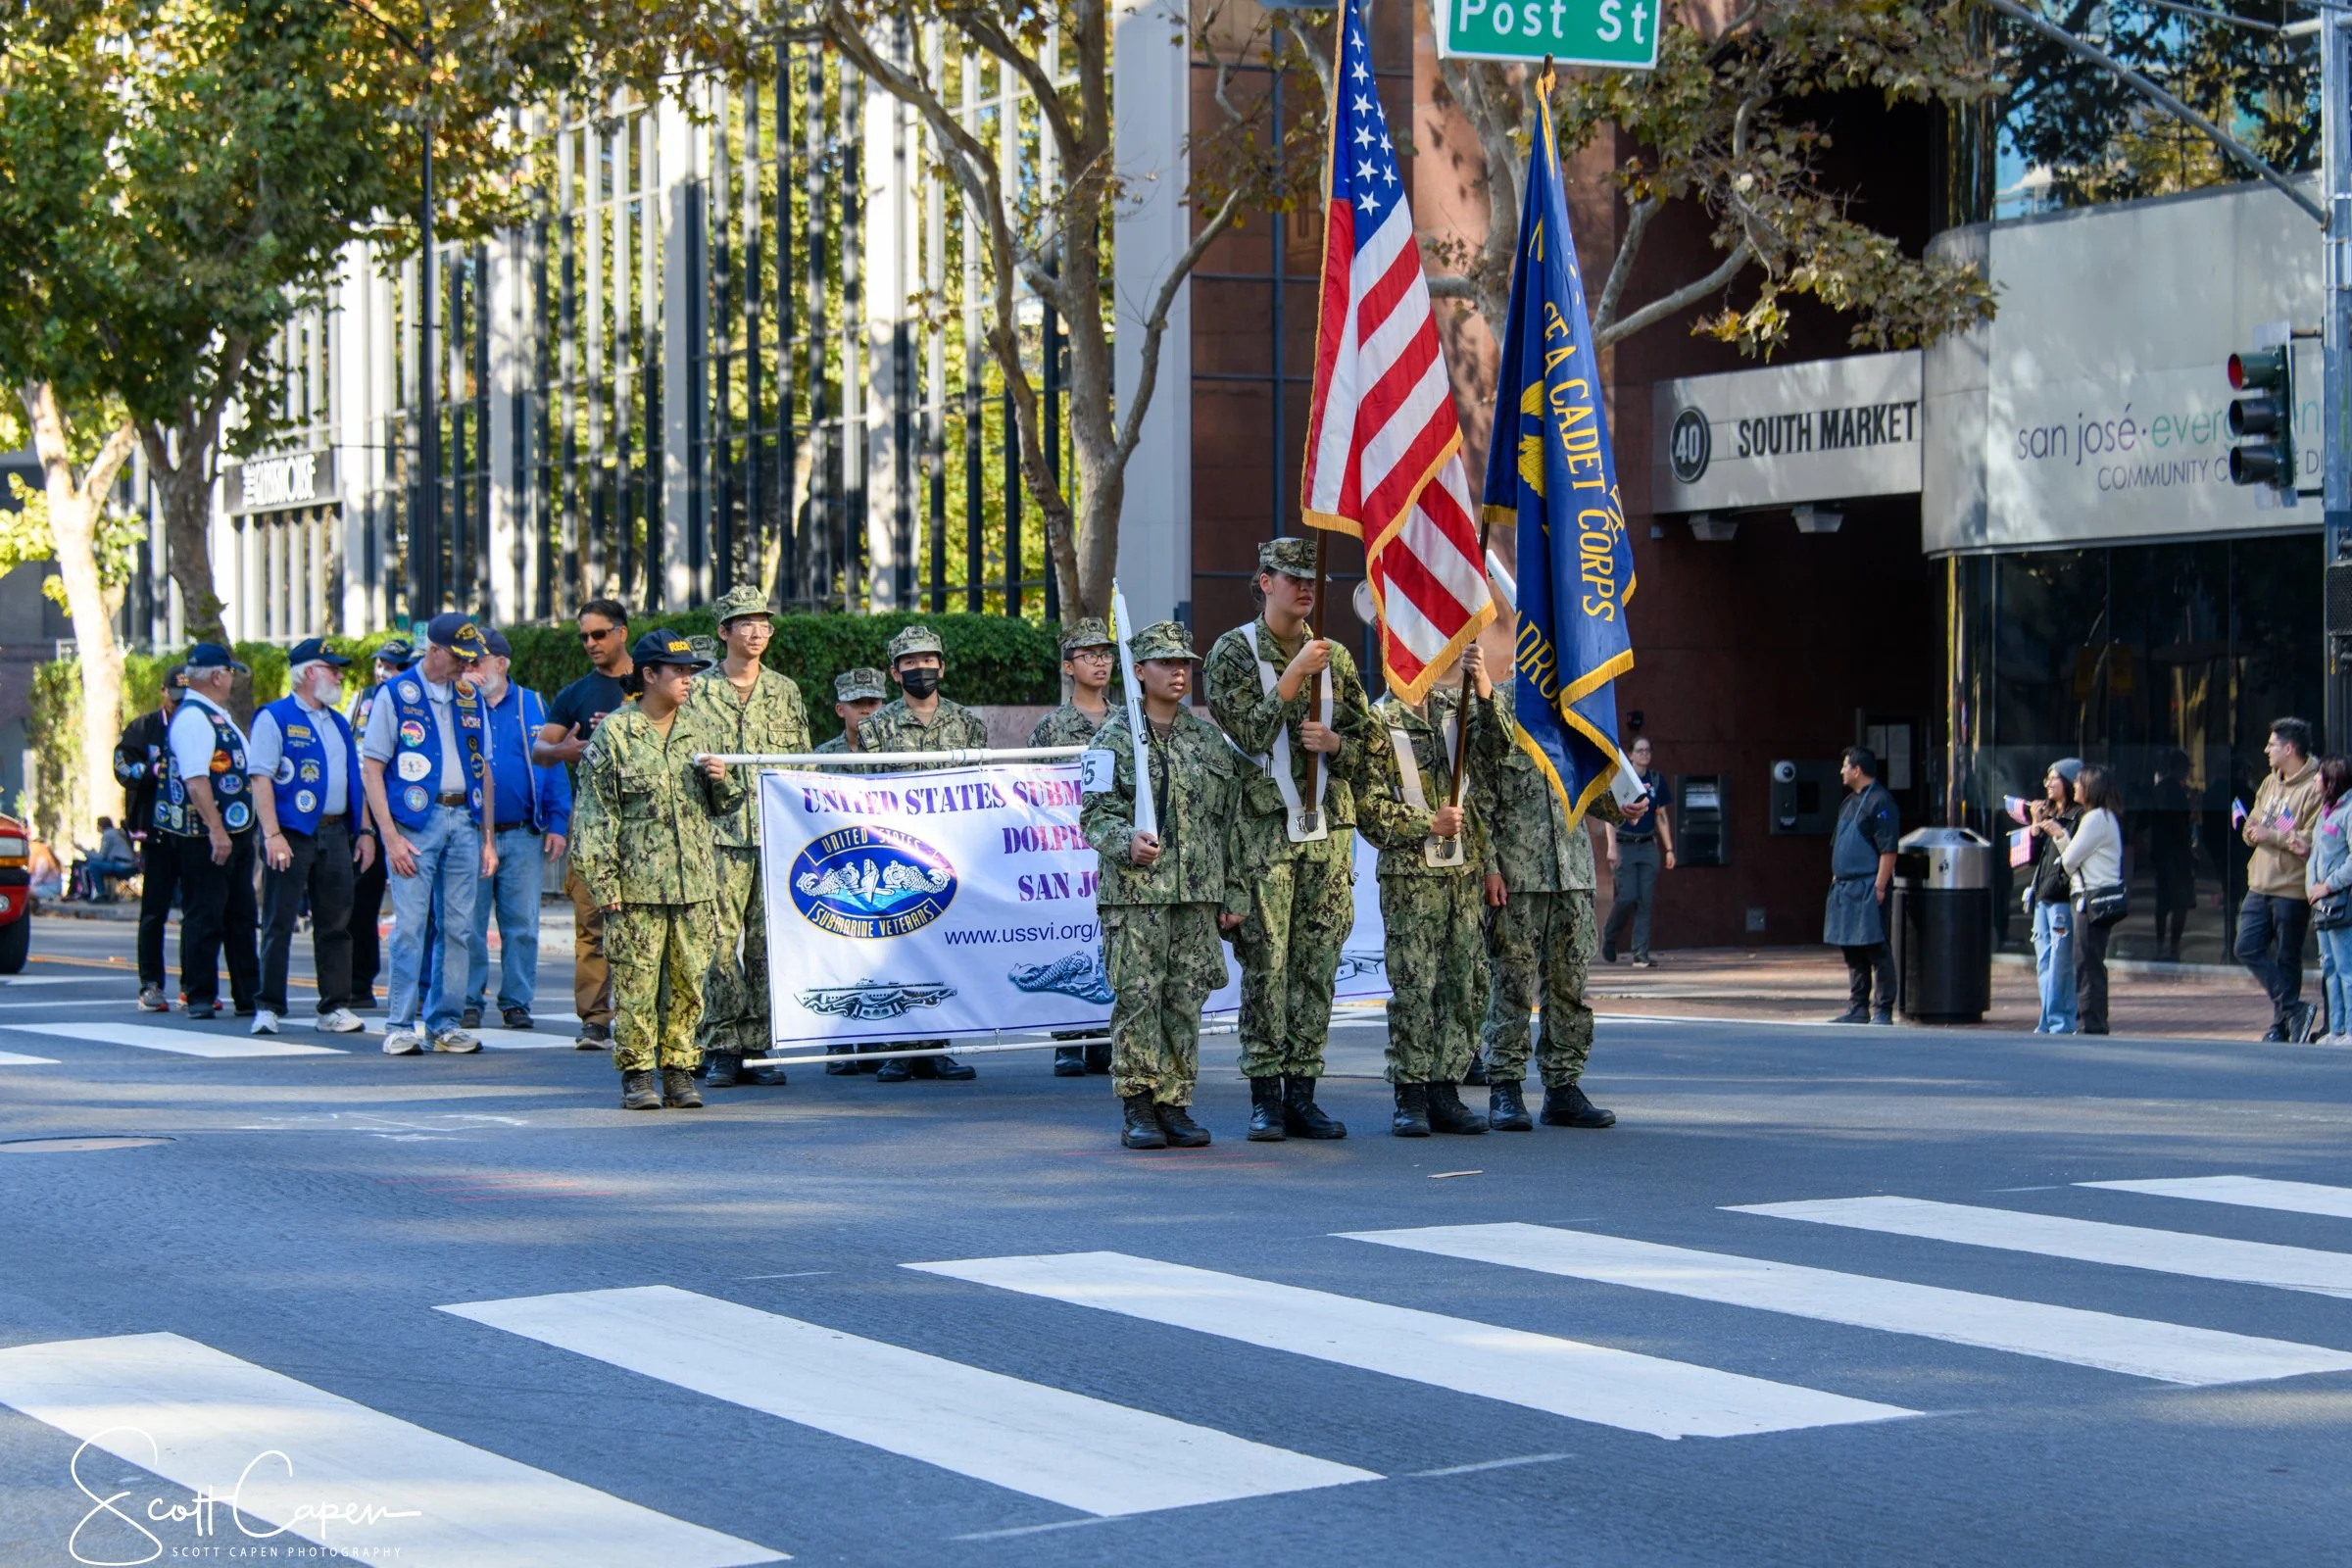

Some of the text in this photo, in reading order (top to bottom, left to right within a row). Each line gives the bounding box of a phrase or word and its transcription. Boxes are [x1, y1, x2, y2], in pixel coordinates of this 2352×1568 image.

[1458, 0, 1648, 45] Post St
[1674, 423, 1702, 465] 40
[1737, 400, 1918, 459] SOUTH MARKET
[2016, 422, 2069, 461] san
[2096, 458, 2209, 492] COMMUNITY
[1548, 377, 1606, 494] CADET
[1577, 508, 1616, 622] CORPS
[802, 786, 900, 815] UNITED
[906, 782, 1007, 815] STATES
[820, 826, 922, 854] UNITED STATES
[1017, 871, 1071, 903] SAN
[811, 906, 935, 938] SUBMARINE VETERANS
[944, 919, 1103, 945] www.ussvi.org/
